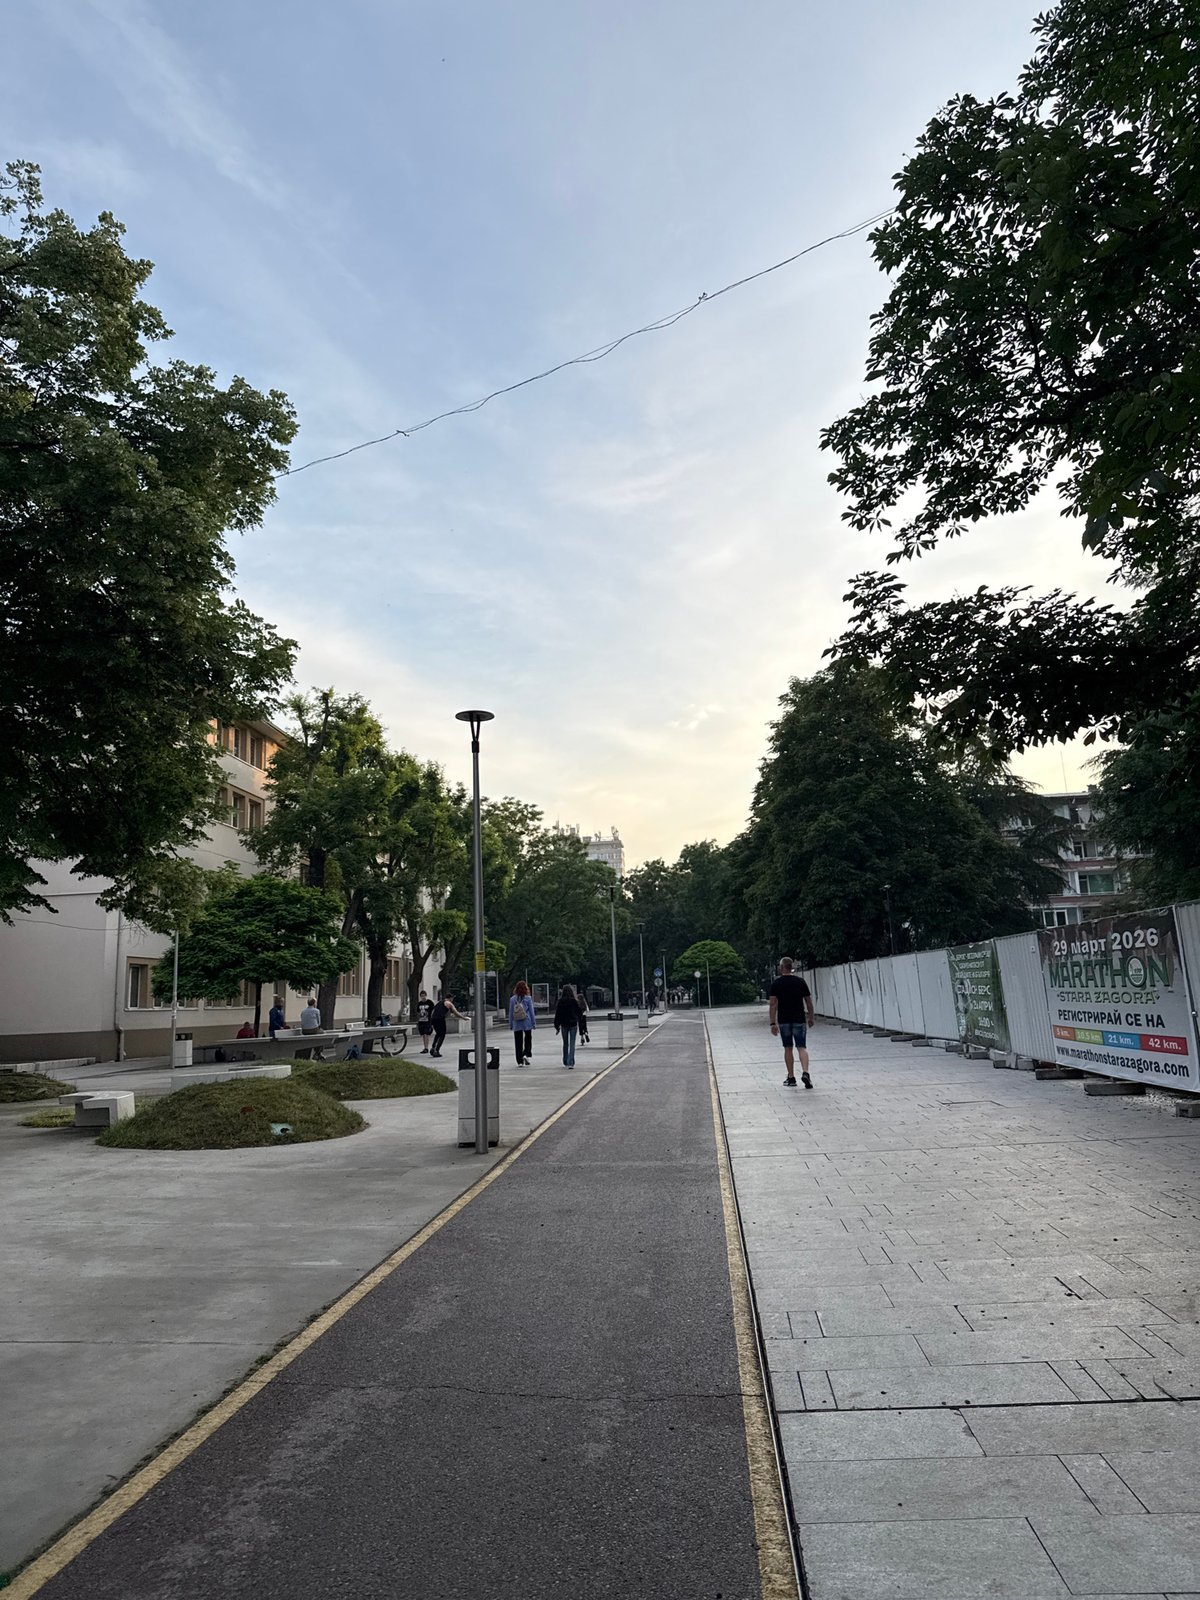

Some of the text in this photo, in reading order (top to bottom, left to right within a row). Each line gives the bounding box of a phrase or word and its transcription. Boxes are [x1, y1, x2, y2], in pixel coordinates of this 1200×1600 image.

[1053, 927, 1159, 956] 29 март 2026
[1048, 954, 1171, 990] MARATHON
[1060, 990, 1156, 1005] STARA ZAGORA
[1058, 1009, 1166, 1028] РЕГИСТРИРАЙ СЕ НА
[1108, 1034, 1134, 1045] 21 km.
[1148, 1038, 1182, 1050] 42 km.
[1056, 1045, 1190, 1077] www.marathonstarazagora.com
